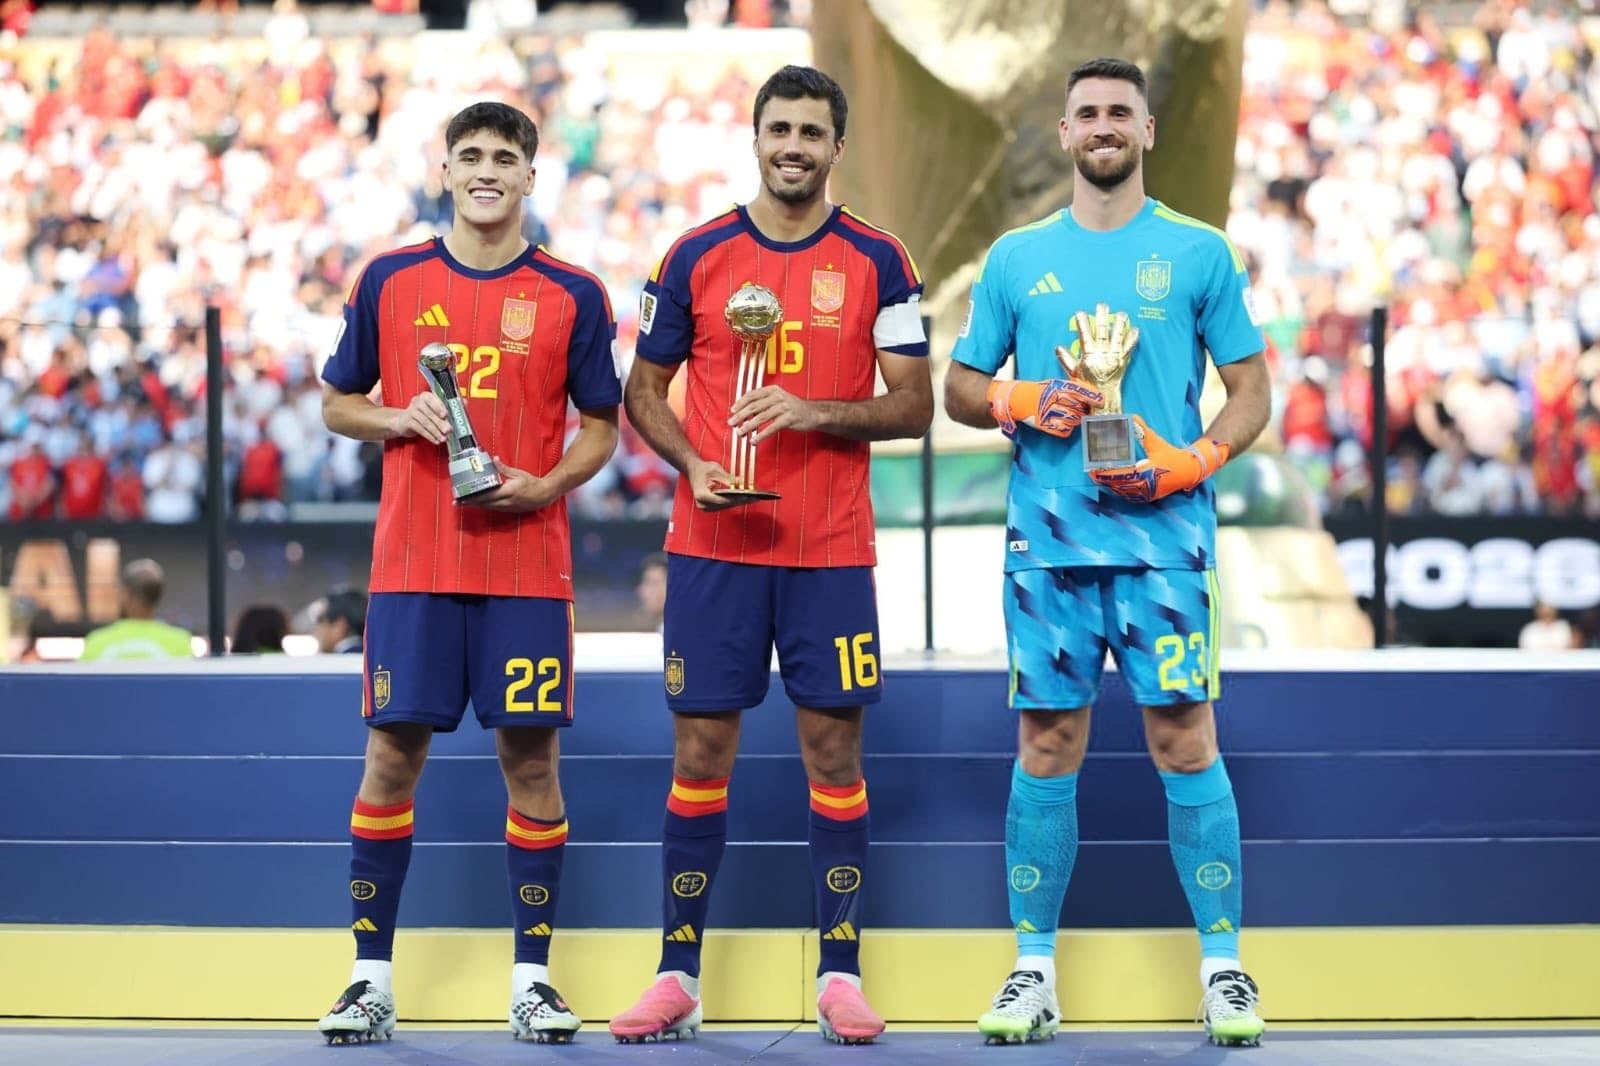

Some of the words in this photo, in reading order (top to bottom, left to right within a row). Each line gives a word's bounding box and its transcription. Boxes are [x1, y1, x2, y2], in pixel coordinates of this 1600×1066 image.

[767, 321, 804, 374] 16
[505, 657, 562, 712] 22
[834, 632, 878, 691] 16
[1155, 632, 1205, 691] 23
